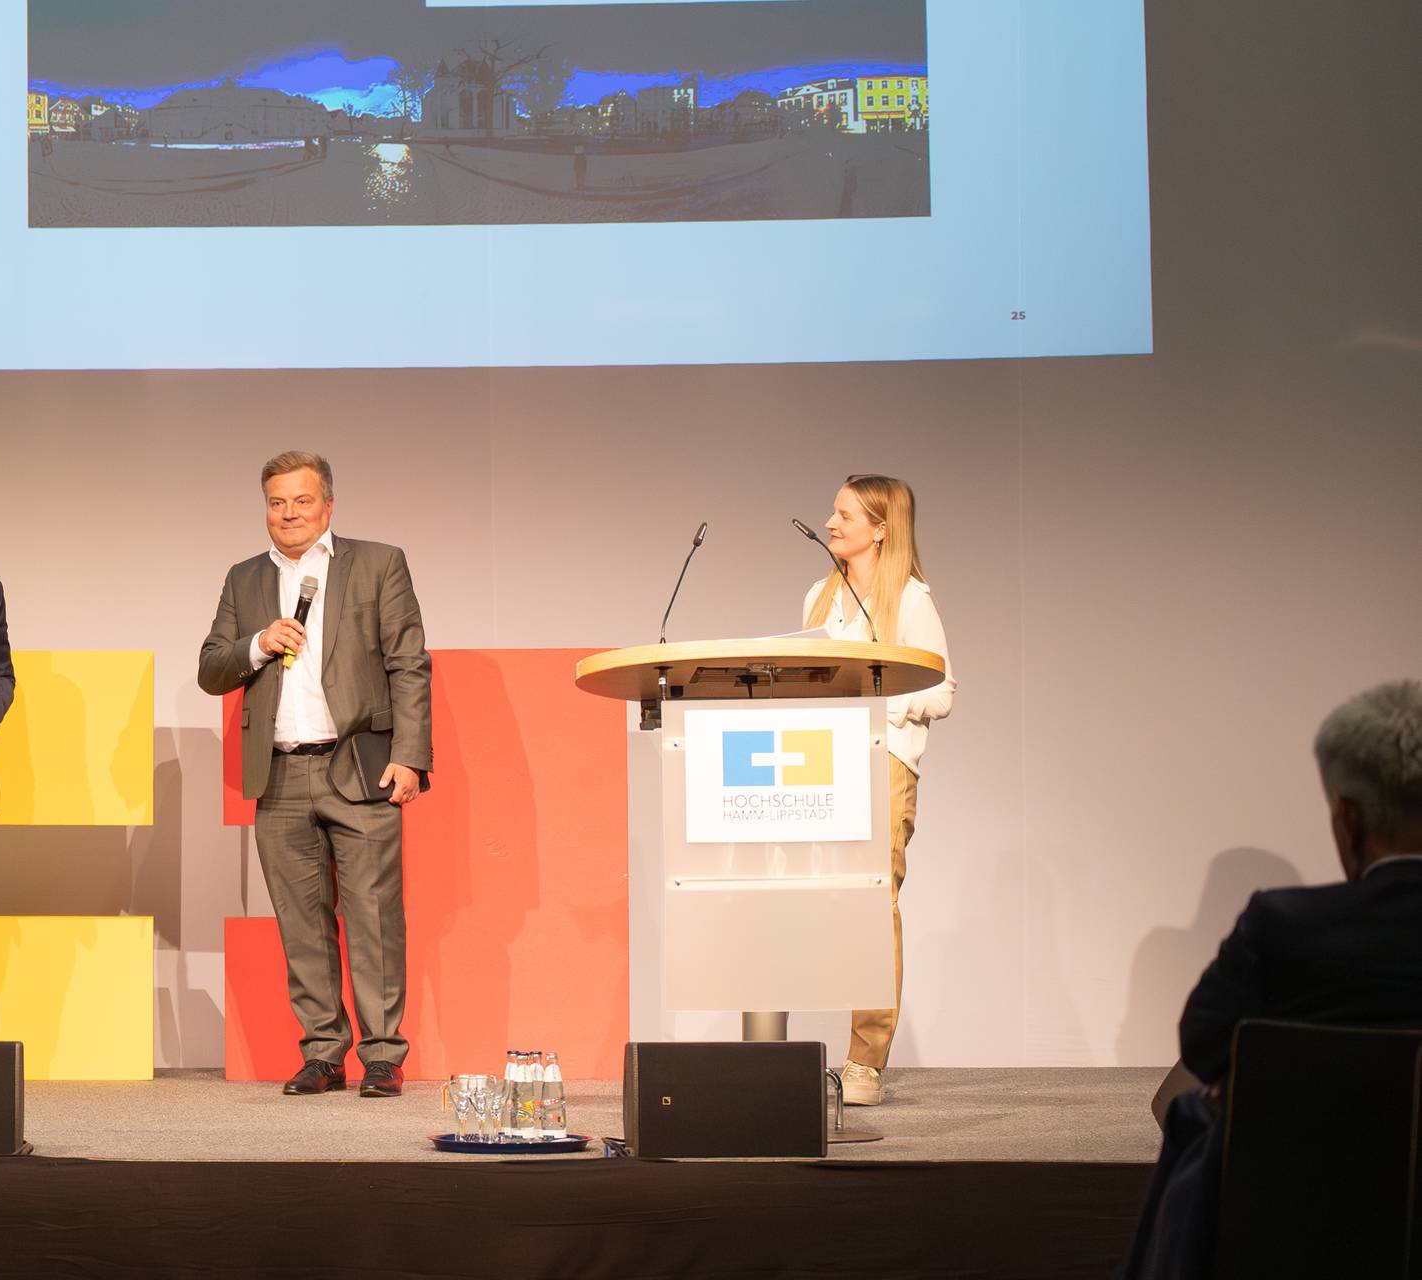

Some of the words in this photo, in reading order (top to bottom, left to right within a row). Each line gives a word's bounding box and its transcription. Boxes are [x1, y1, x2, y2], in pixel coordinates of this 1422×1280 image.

[1011, 311, 1026, 320] 25
[722, 793, 835, 809] HOCHSCHULE
[722, 808, 835, 822] HAMM-LIPPSTADT
